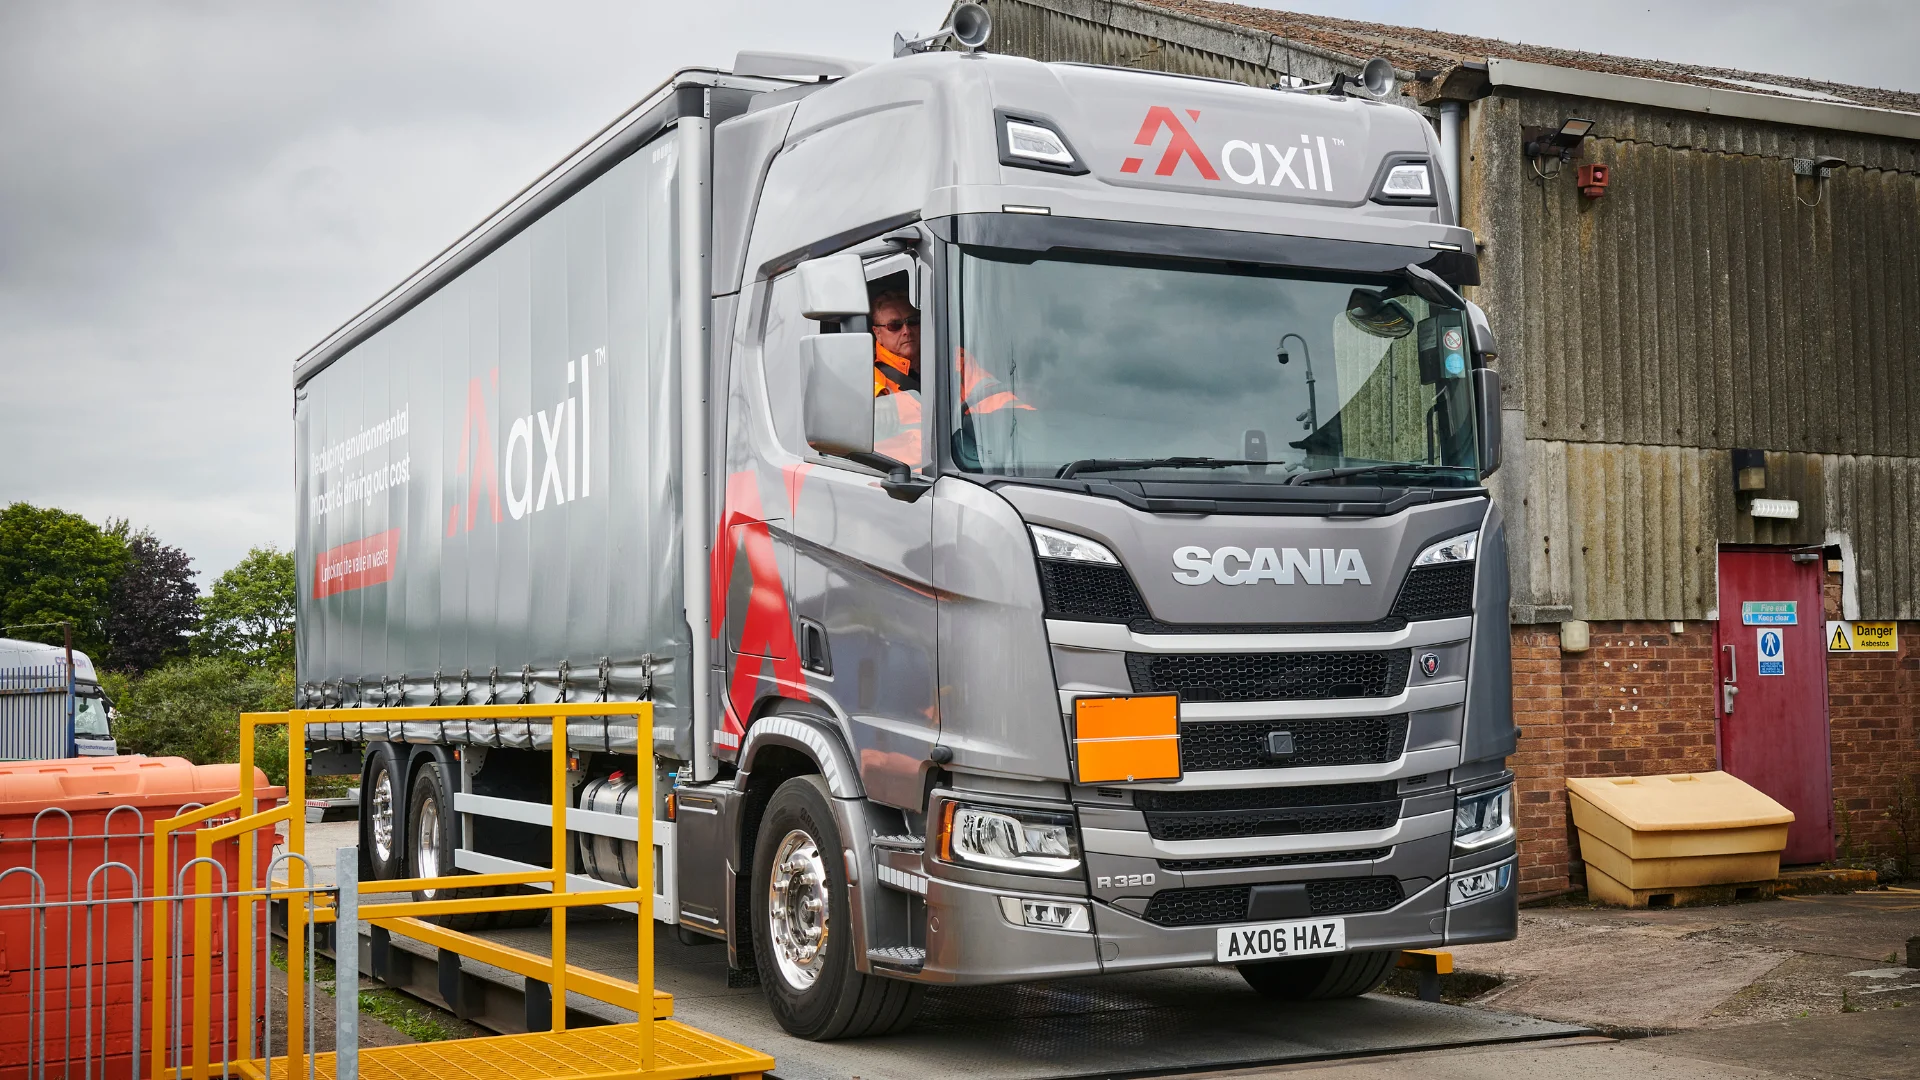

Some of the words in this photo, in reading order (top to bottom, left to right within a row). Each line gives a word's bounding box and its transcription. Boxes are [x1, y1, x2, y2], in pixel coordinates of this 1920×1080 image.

[1221, 134, 1334, 192] axil
[345, 402, 409, 461] environmental
[505, 353, 590, 521] axil
[344, 469, 372, 507] driving
[373, 461, 389, 494] out
[389, 451, 411, 488] cost
[1171, 545, 1372, 586] SCANIA
[1757, 614, 1774, 623] Keep
[1760, 603, 1774, 612] Fire
[1775, 603, 1788, 612] exit
[1856, 625, 1894, 639] Danger
[1097, 876, 1111, 889] R
[1114, 873, 1156, 888] 320
[1228, 928, 1287, 957] AX06
[1293, 923, 1337, 951] HAZ
